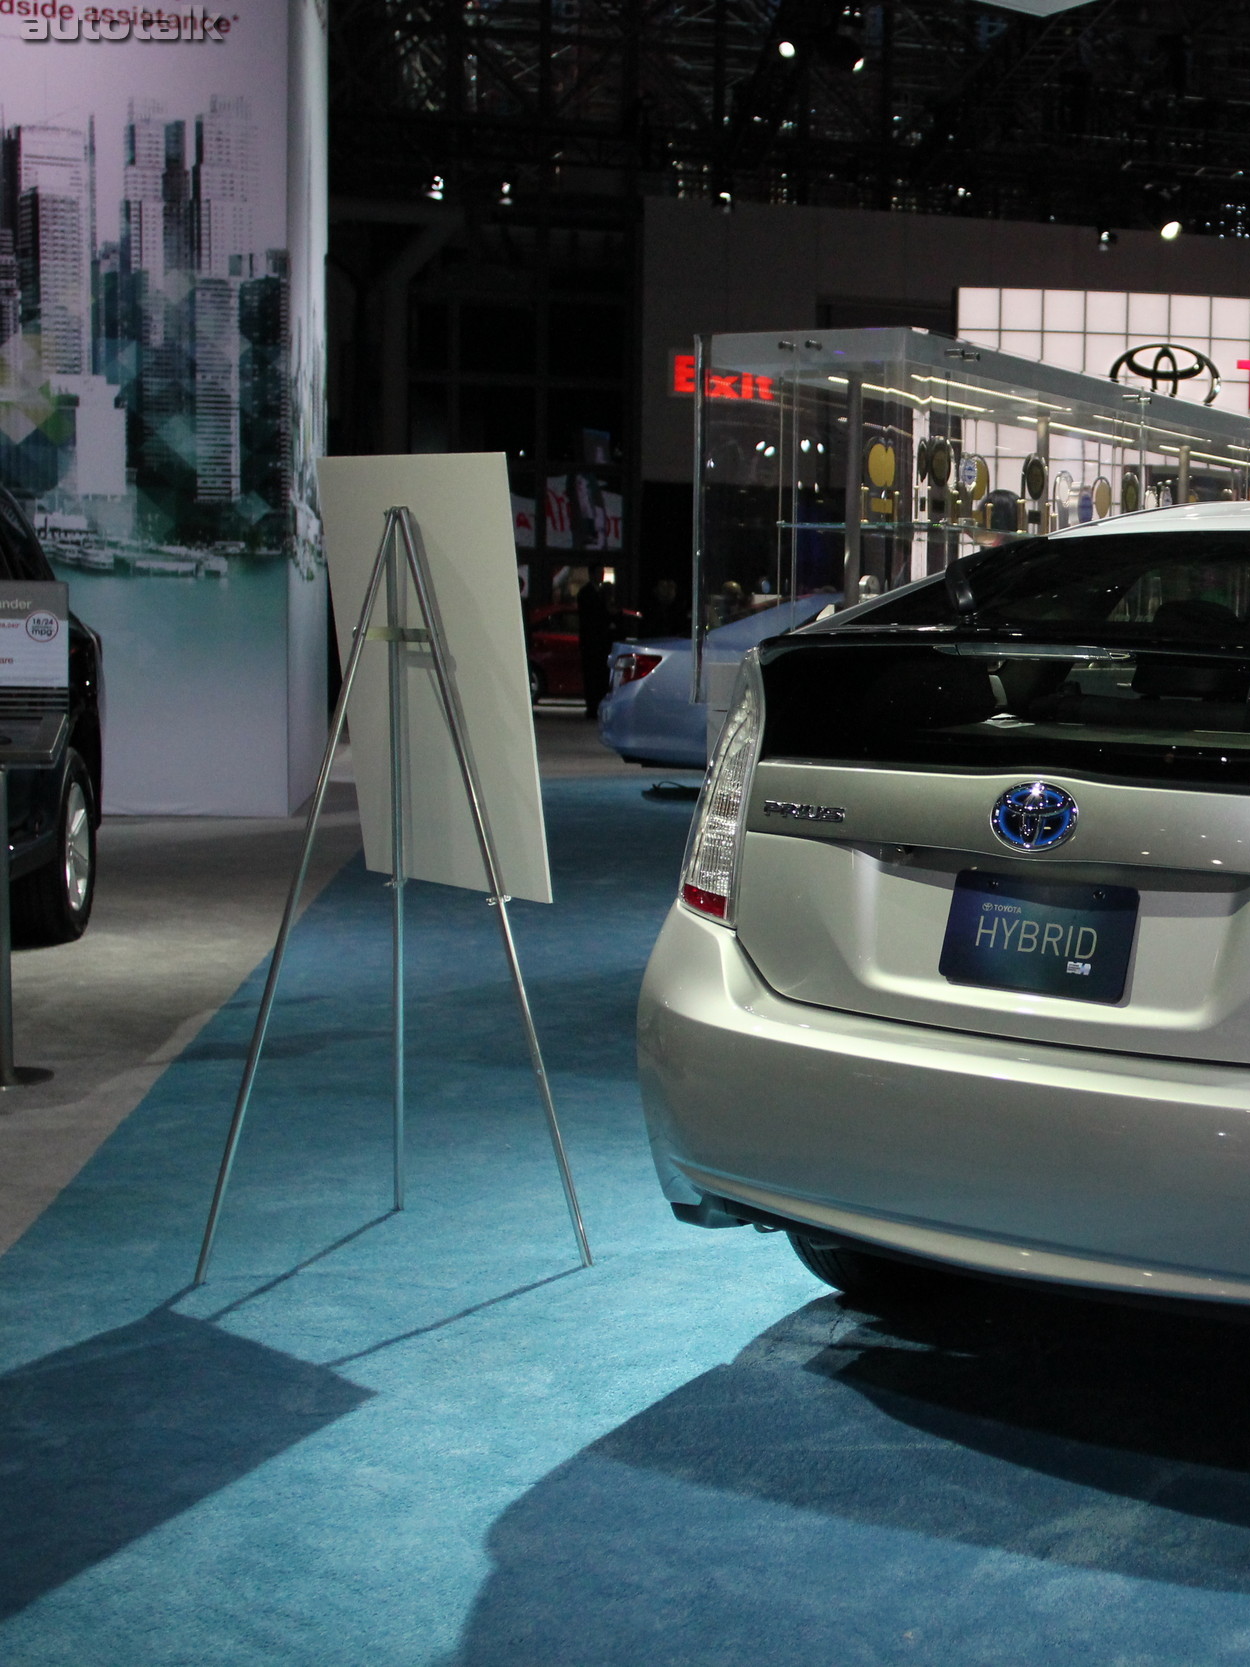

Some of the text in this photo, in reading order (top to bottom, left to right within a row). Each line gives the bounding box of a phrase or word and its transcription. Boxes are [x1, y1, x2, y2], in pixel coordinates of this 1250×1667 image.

[674, 355, 774, 400] Exit
[763, 800, 845, 822] PRIUS
[994, 904, 1022, 914] TOYOTA
[975, 915, 1098, 960] HYBRID
